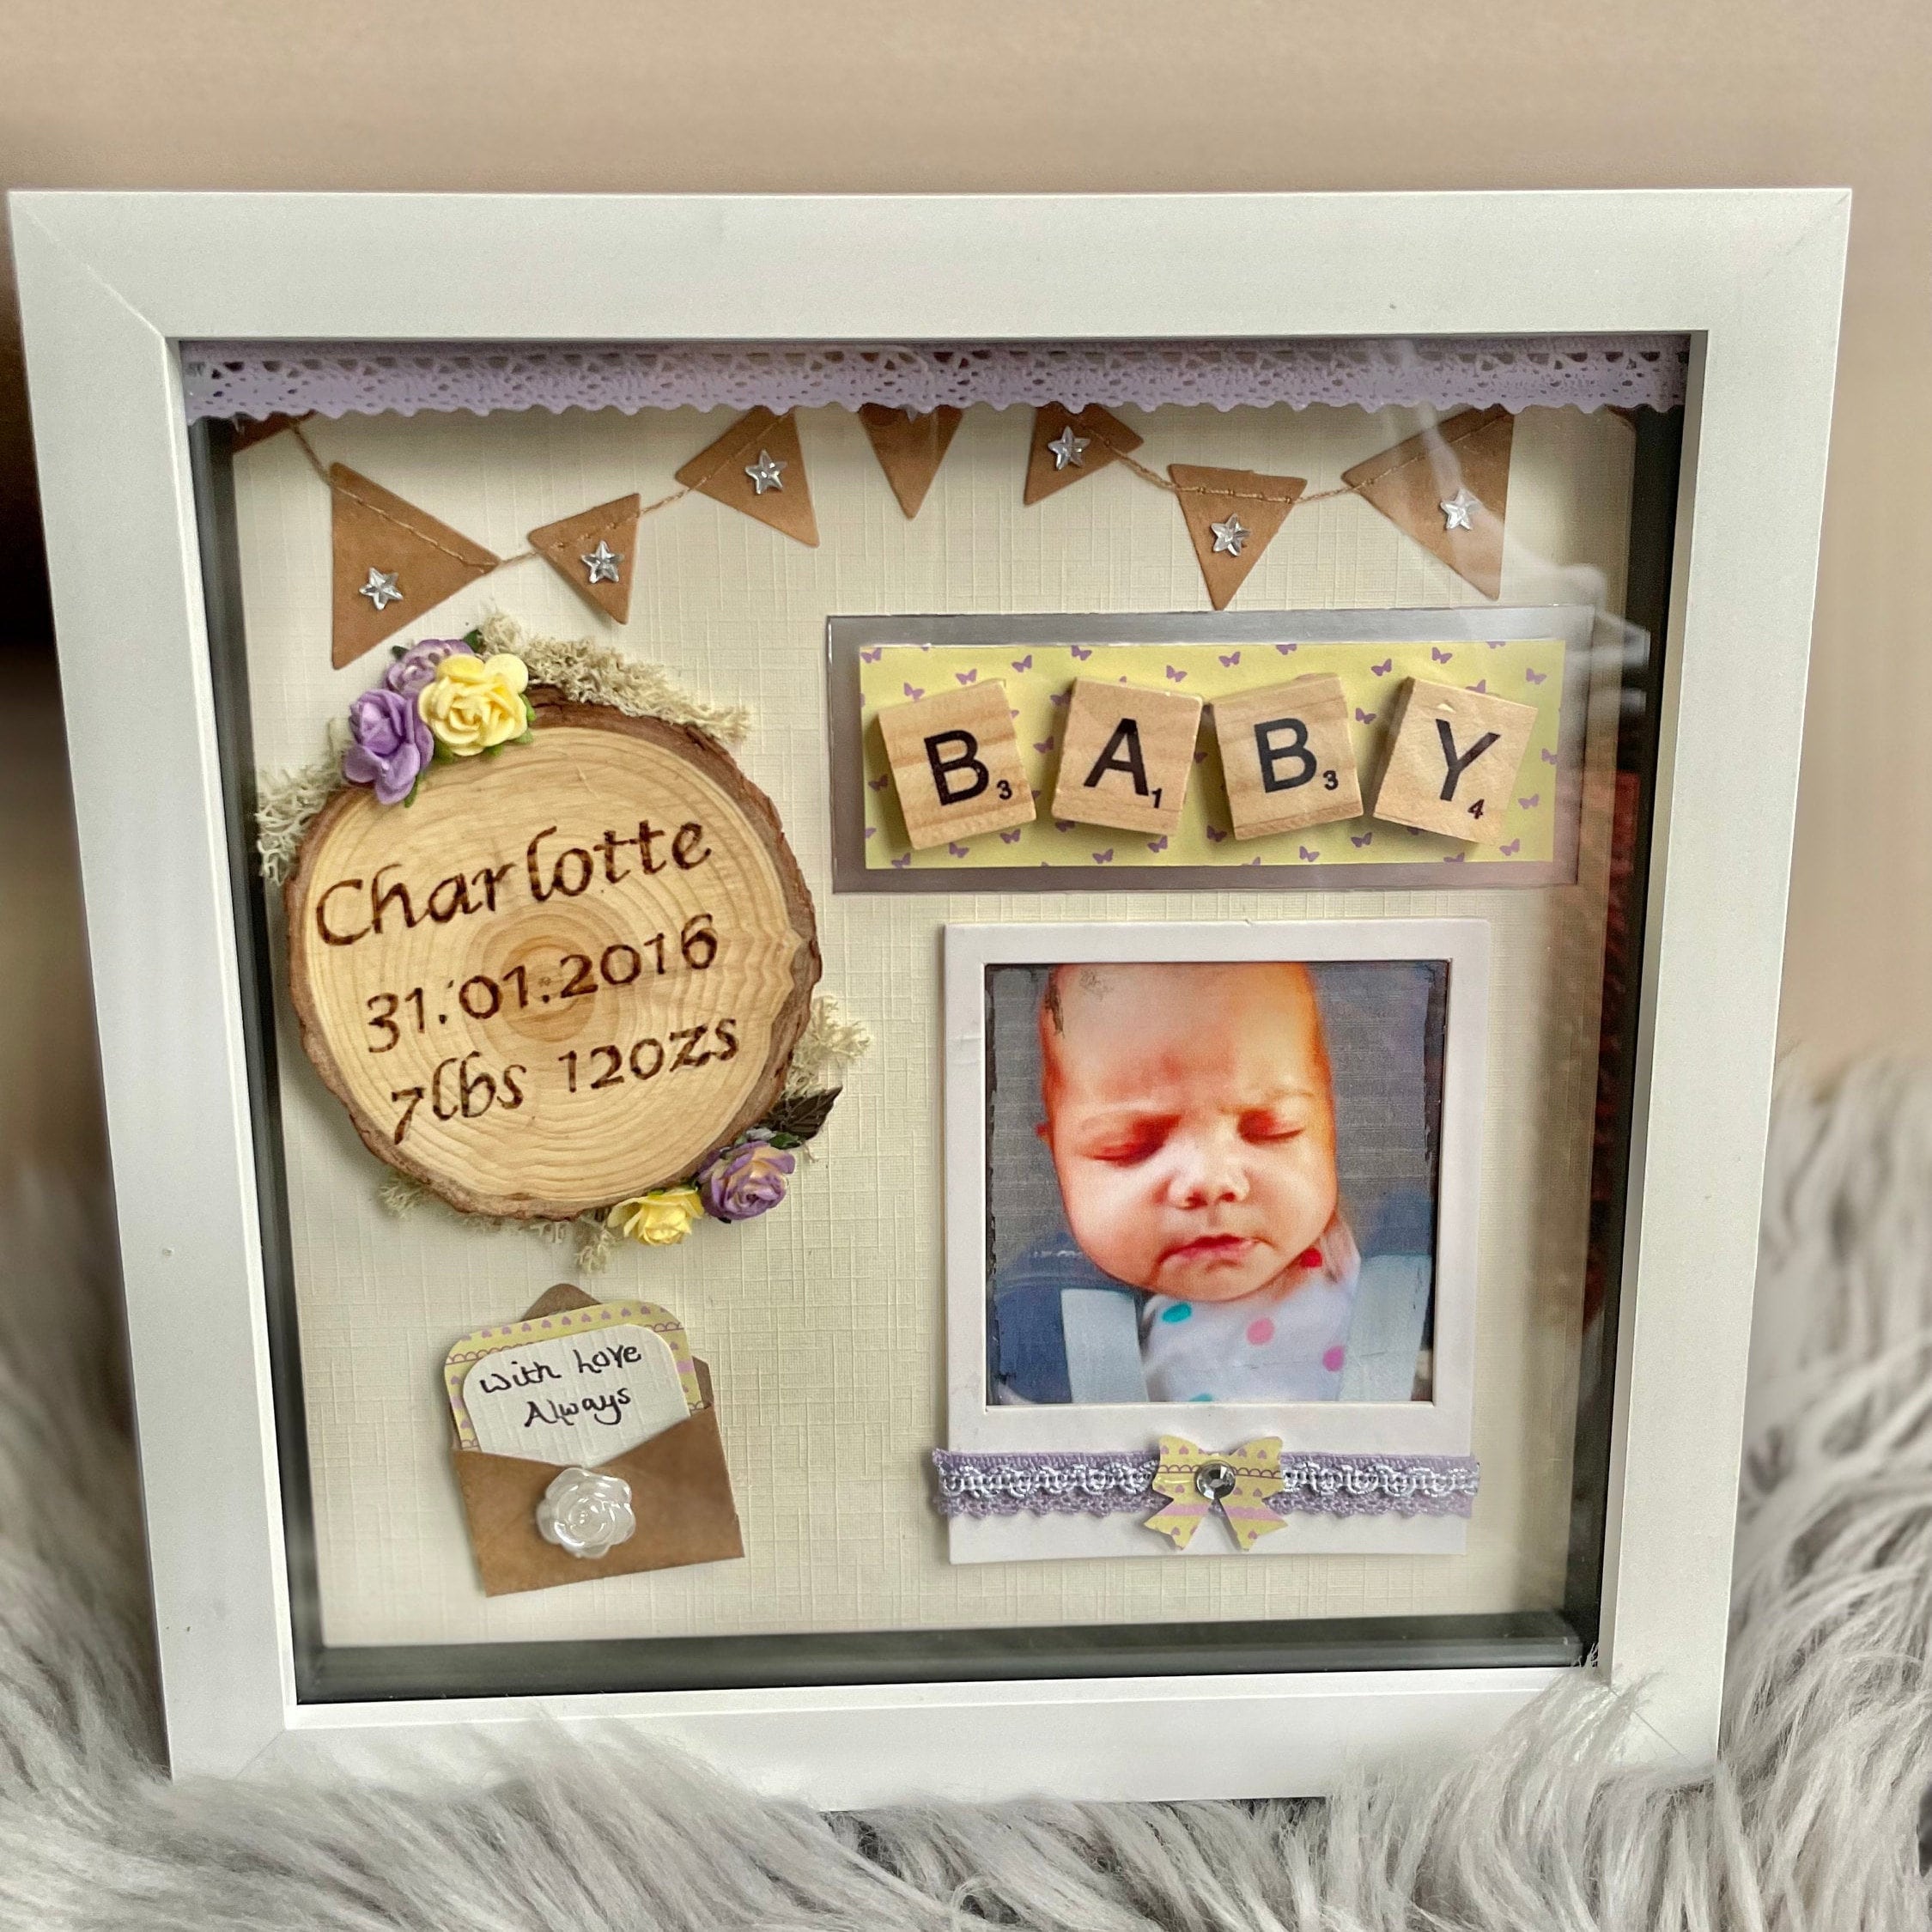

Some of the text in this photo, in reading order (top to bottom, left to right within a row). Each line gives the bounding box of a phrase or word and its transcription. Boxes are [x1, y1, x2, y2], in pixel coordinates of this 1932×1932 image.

[996, 780, 1013, 800] 3
[1323, 770, 1340, 791] 3
[1150, 787, 1163, 809] 1
[1467, 799, 1485, 820] 4
[316, 819, 713, 945] Charlotte
[391, 1051, 527, 1145] 7lbs
[524, 1388, 631, 1427] Always
